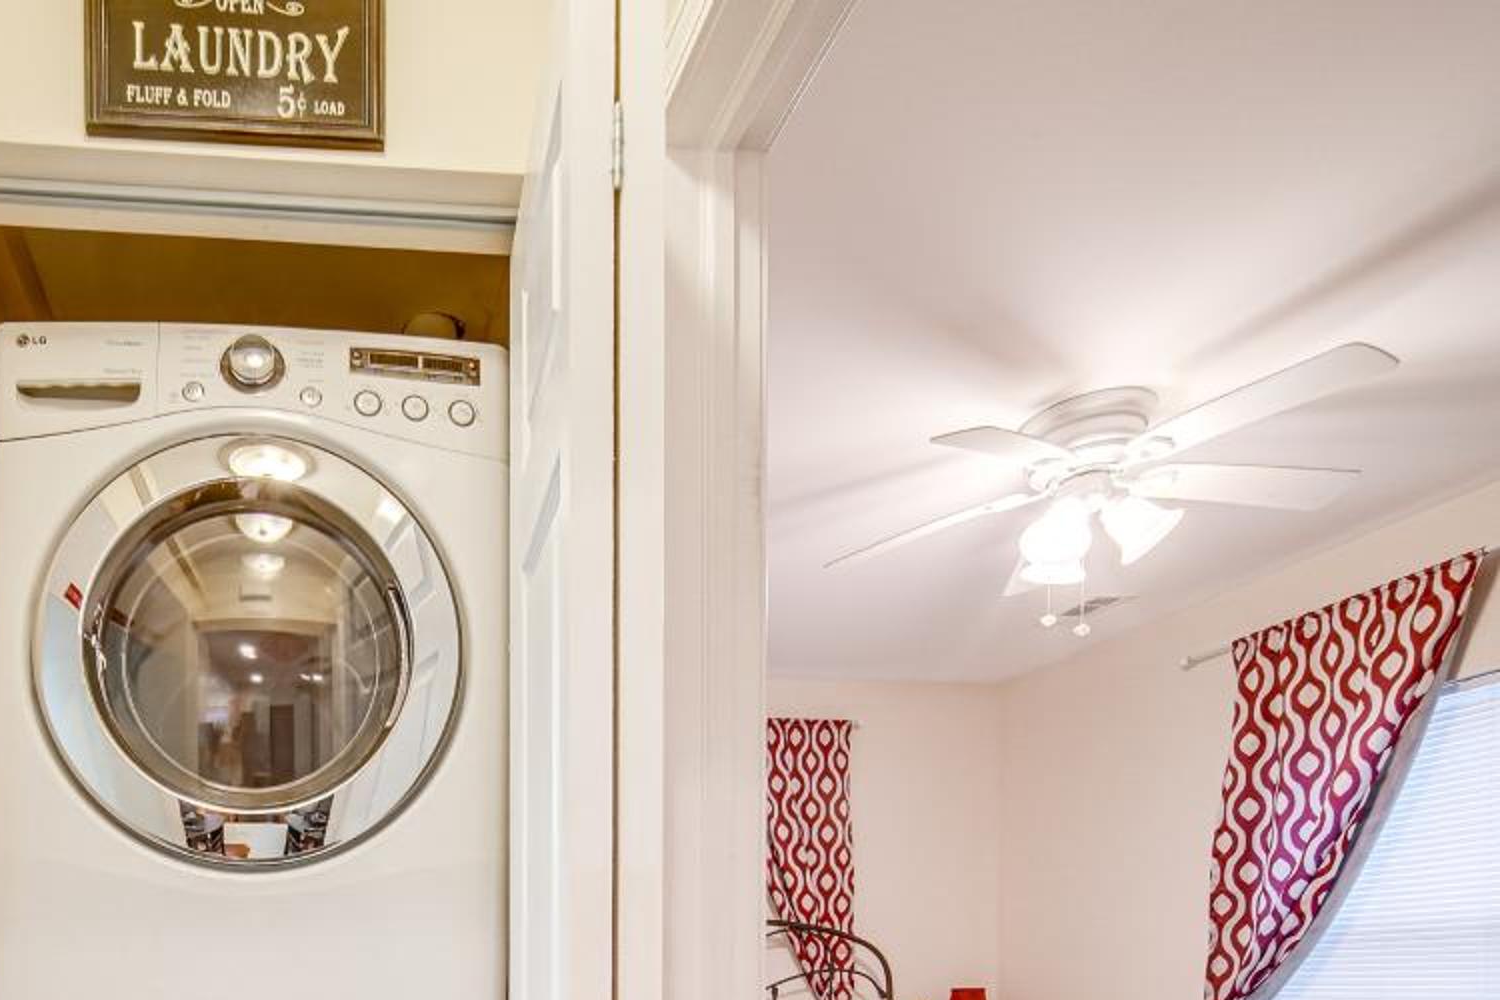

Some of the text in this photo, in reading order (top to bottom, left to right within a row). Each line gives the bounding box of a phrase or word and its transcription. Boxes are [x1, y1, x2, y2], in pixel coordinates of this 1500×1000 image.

[132, 21, 350, 84] LAUNDRY
[126, 84, 173, 105] FLUFF
[177, 88, 189, 106] &
[193, 88, 232, 108] FOLD
[314, 100, 345, 116] LOAD
[32, 336, 47, 345] LG
